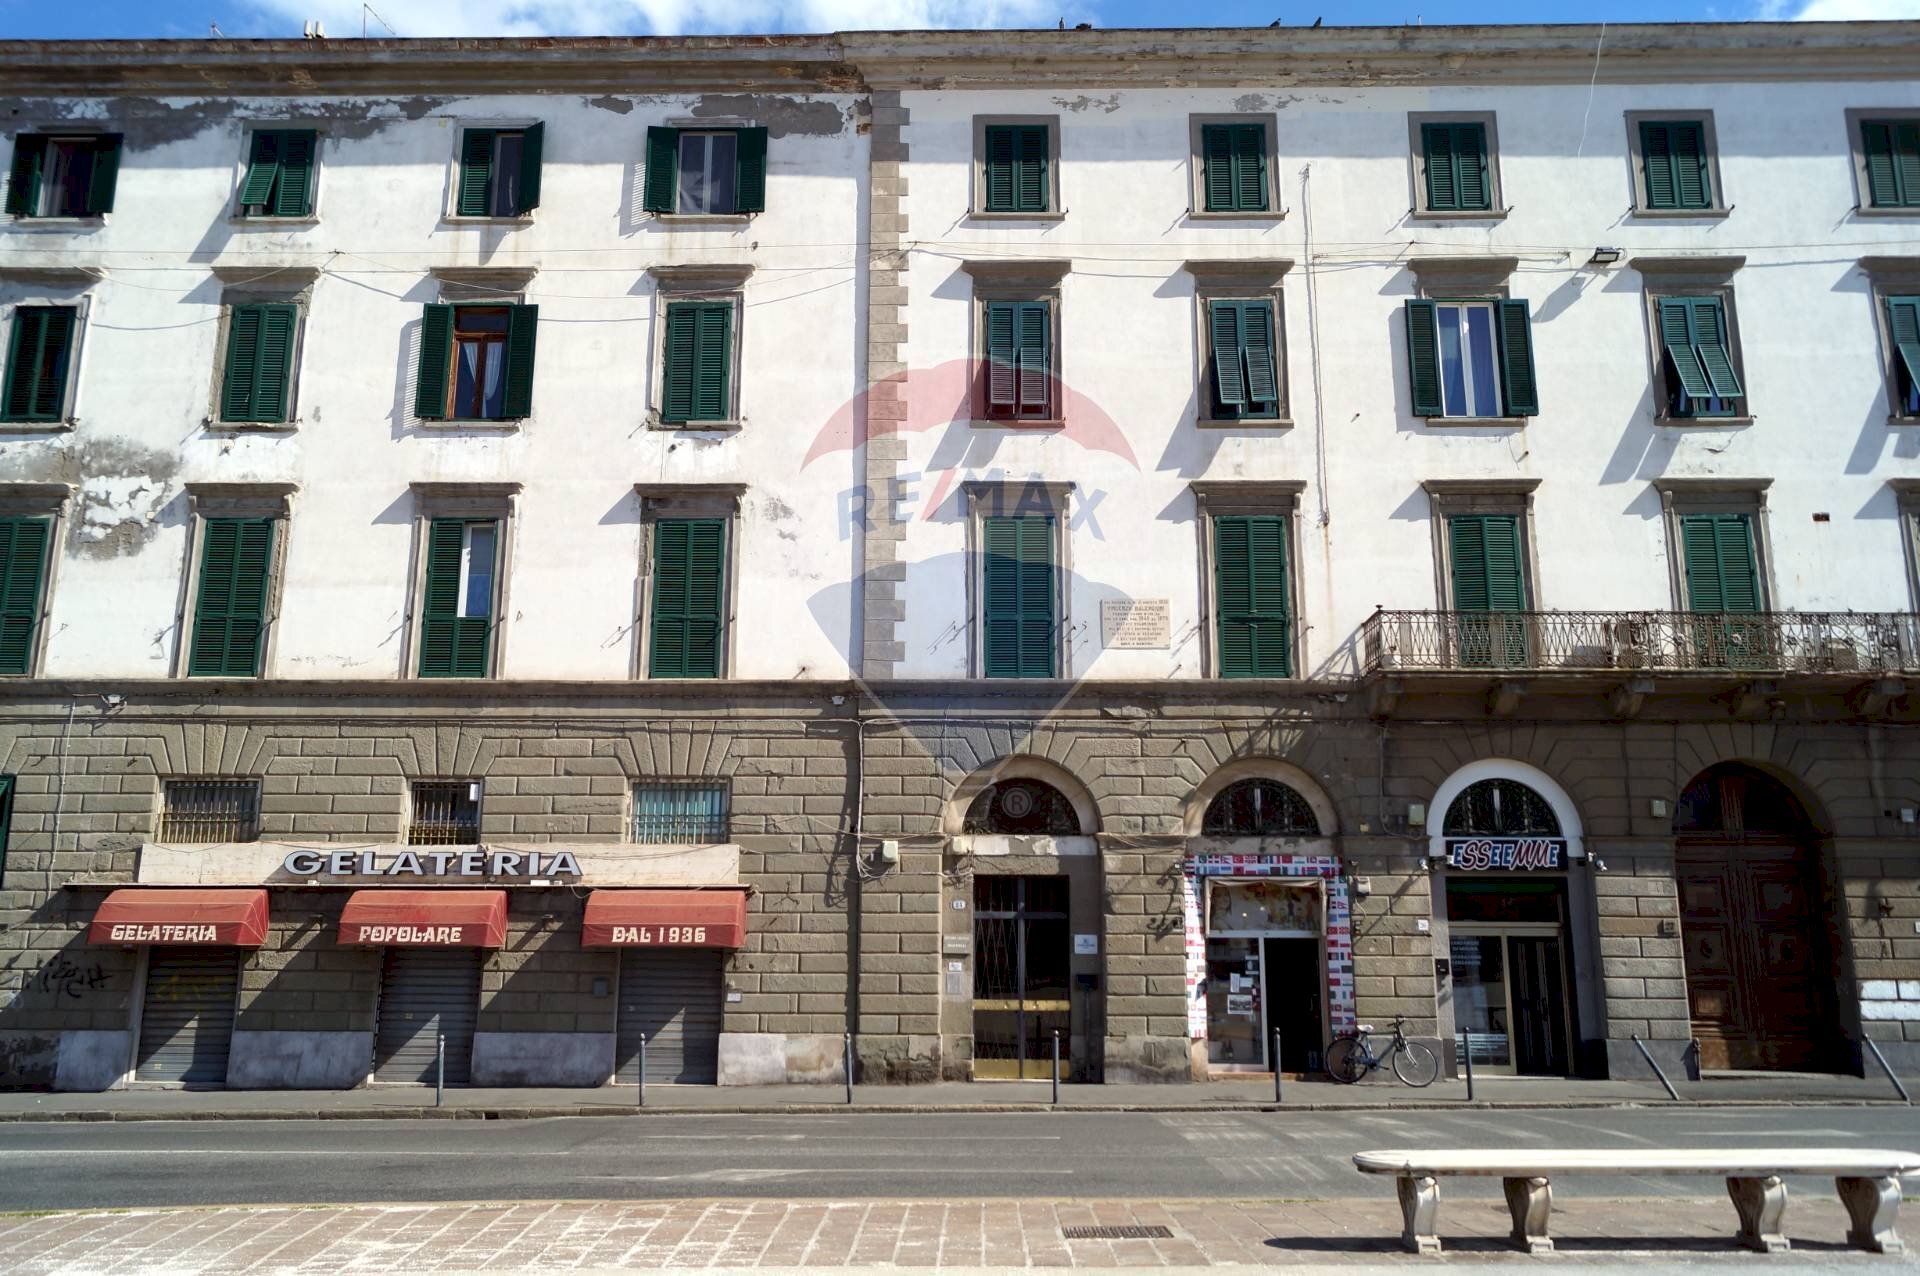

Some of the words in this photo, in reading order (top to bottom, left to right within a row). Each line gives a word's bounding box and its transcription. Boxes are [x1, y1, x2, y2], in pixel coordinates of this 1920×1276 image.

[284, 850, 583, 876] GELATERIA
[111, 925, 217, 942] GELATERIA
[359, 926, 462, 944] POPOLARE
[612, 927, 651, 943] DAL
[658, 927, 706, 943] 1936
